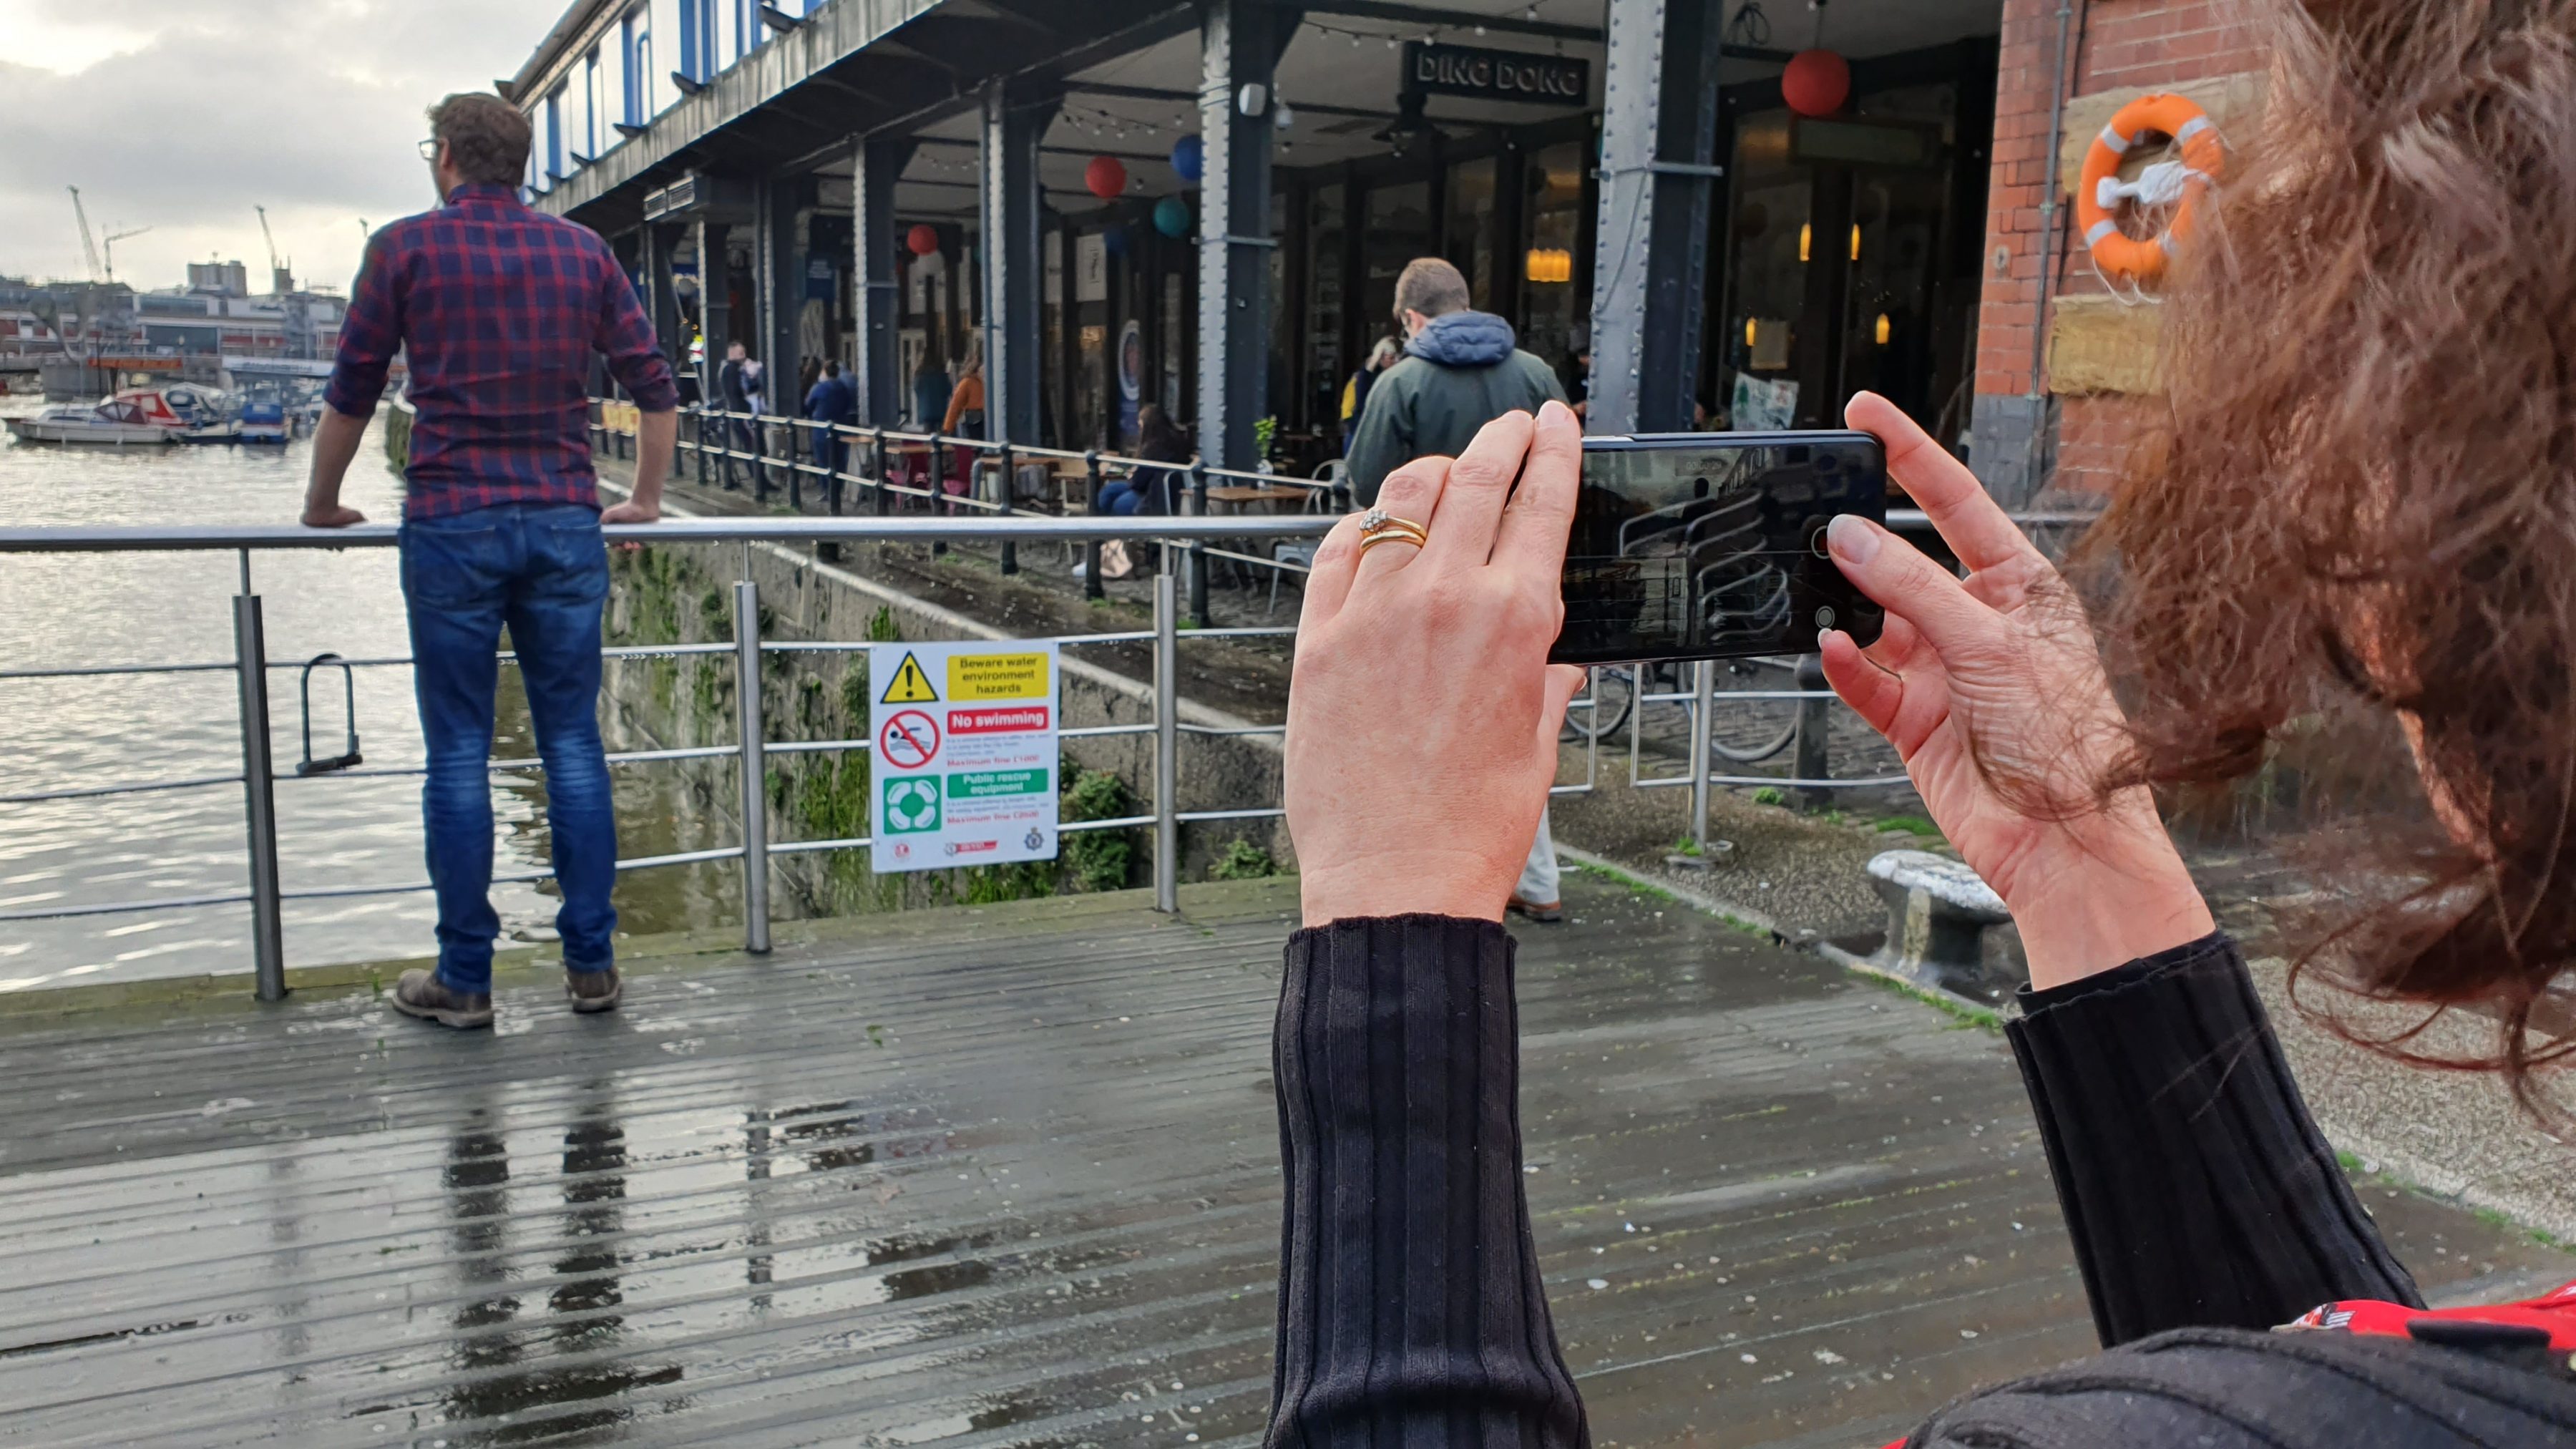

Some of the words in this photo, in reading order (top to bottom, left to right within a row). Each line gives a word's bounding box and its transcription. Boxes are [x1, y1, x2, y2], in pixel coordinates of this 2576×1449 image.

[1417, 53, 1490, 87] DING
[1496, 60, 1581, 96] DONG
[960, 657, 1003, 669] Beware
[1007, 656, 1038, 667] water
[962, 669, 1035, 681] environment
[976, 683, 1022, 694] hazards
[952, 715, 972, 728] No
[976, 712, 1045, 728] swimming
[947, 758, 992, 768] Maximum
[962, 774, 995, 785] Public
[997, 772, 1032, 782] rescue
[970, 782, 1024, 795] equipment
[947, 814, 992, 824] Maximum
[994, 812, 1011, 821] fine
